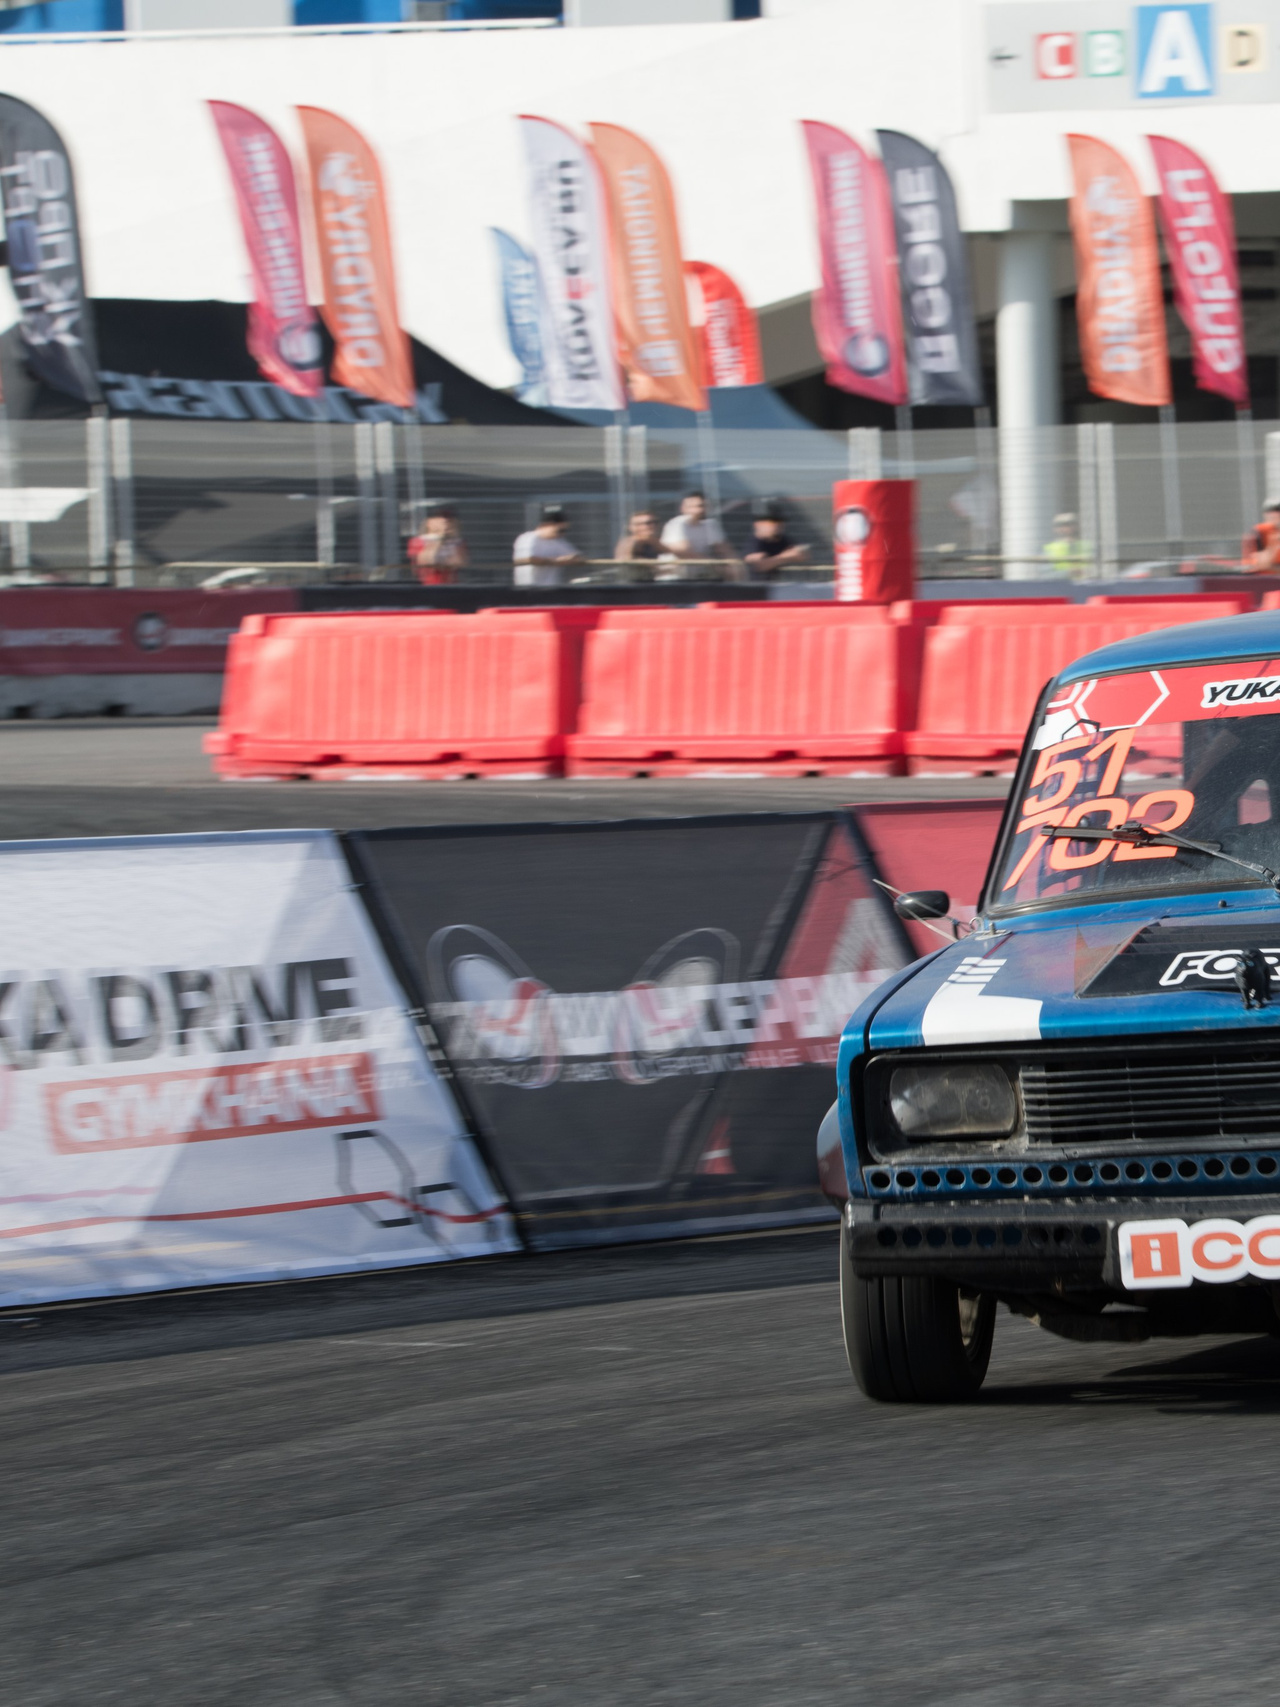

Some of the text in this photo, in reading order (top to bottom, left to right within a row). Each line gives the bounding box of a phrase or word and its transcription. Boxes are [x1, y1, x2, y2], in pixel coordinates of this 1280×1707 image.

[1041, 10, 1260, 92] C B A D
[1021, 727, 1137, 817] 51
[91, 956, 364, 1061] DRIVE
